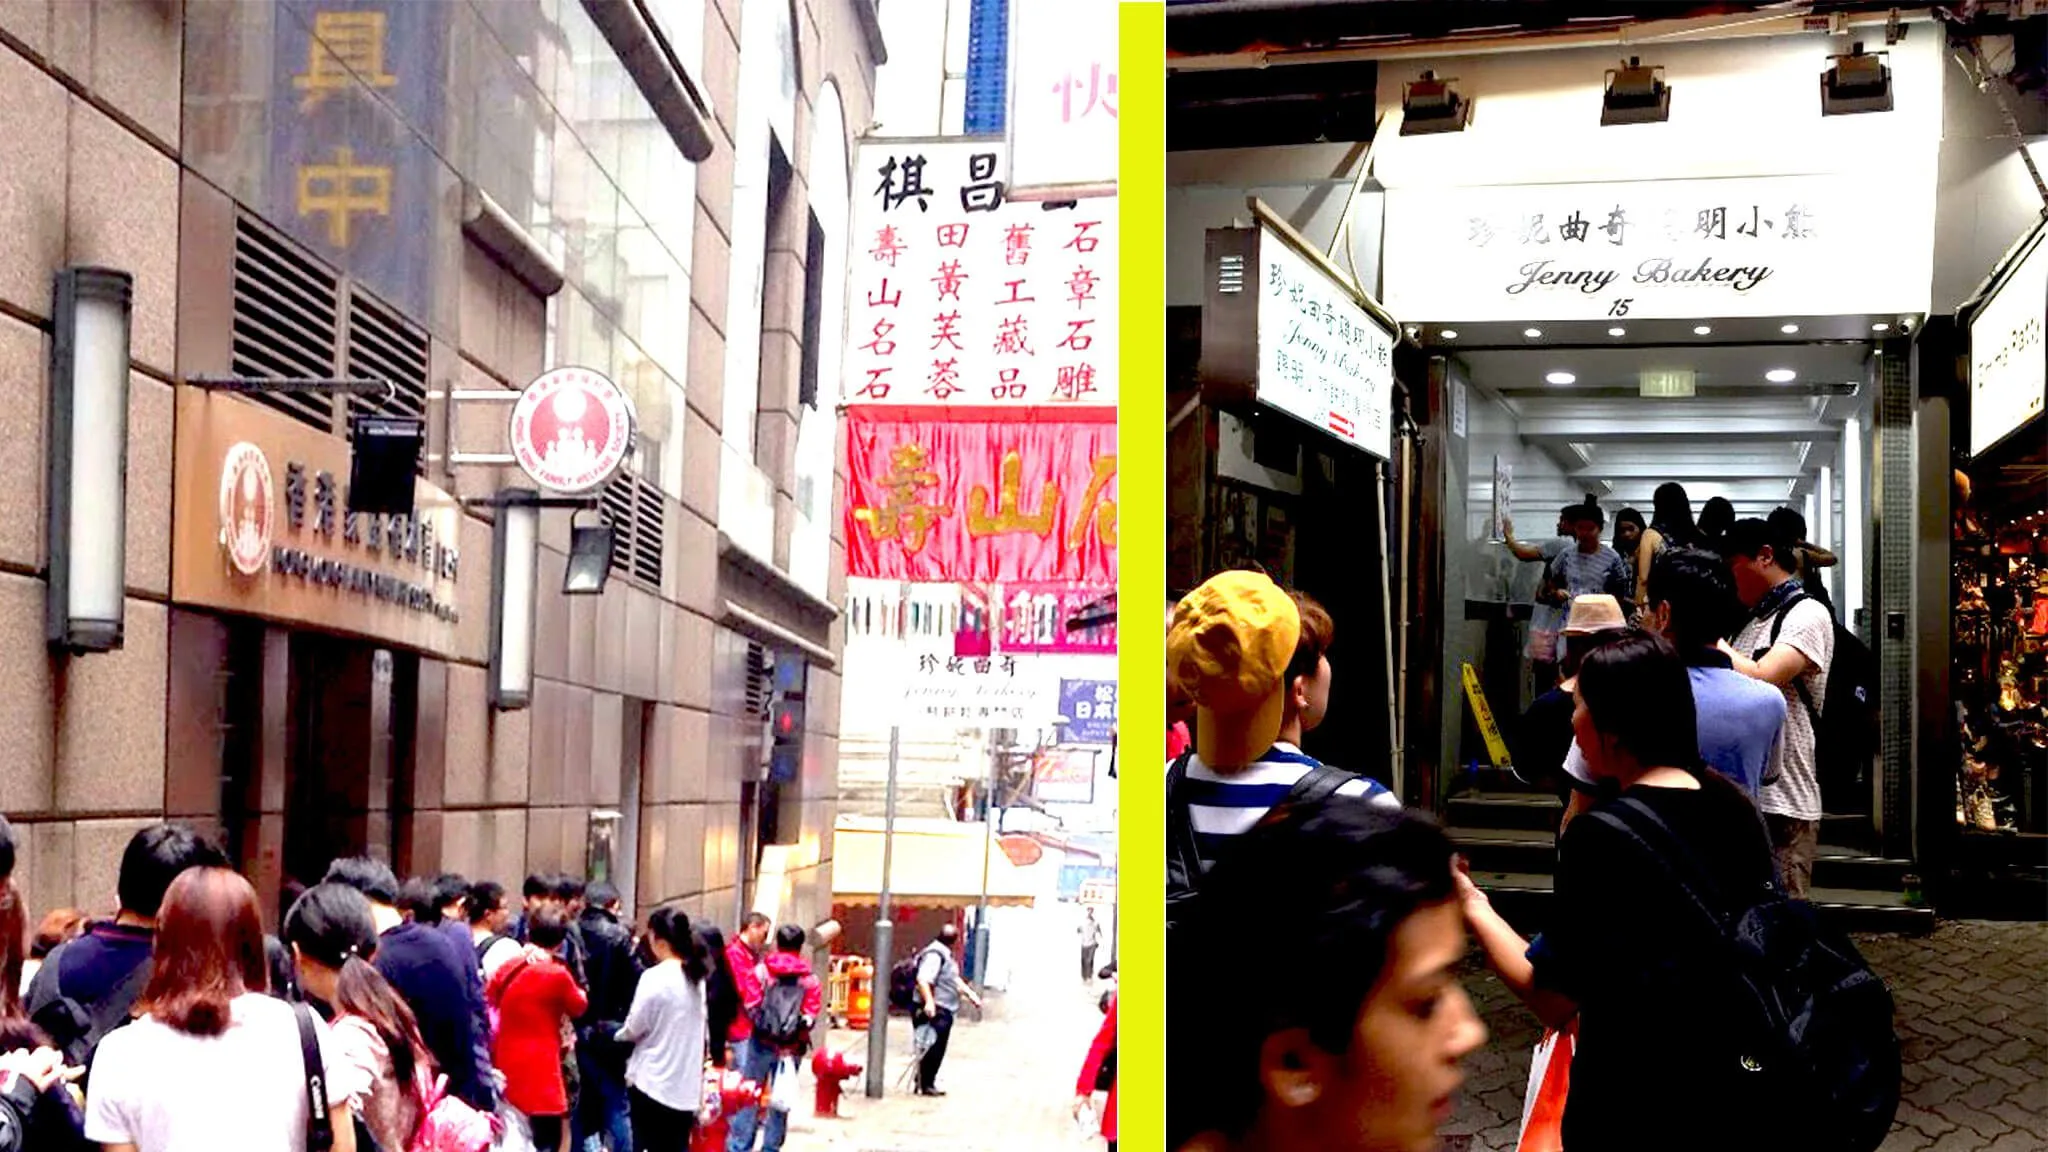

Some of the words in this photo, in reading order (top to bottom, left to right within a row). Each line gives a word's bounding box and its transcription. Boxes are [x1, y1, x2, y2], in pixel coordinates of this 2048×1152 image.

[874, 153, 1078, 213] 棋昌
[1505, 259, 1620, 294] Jenny
[1633, 257, 1774, 291] Bakery
[1608, 298, 1633, 316] 15
